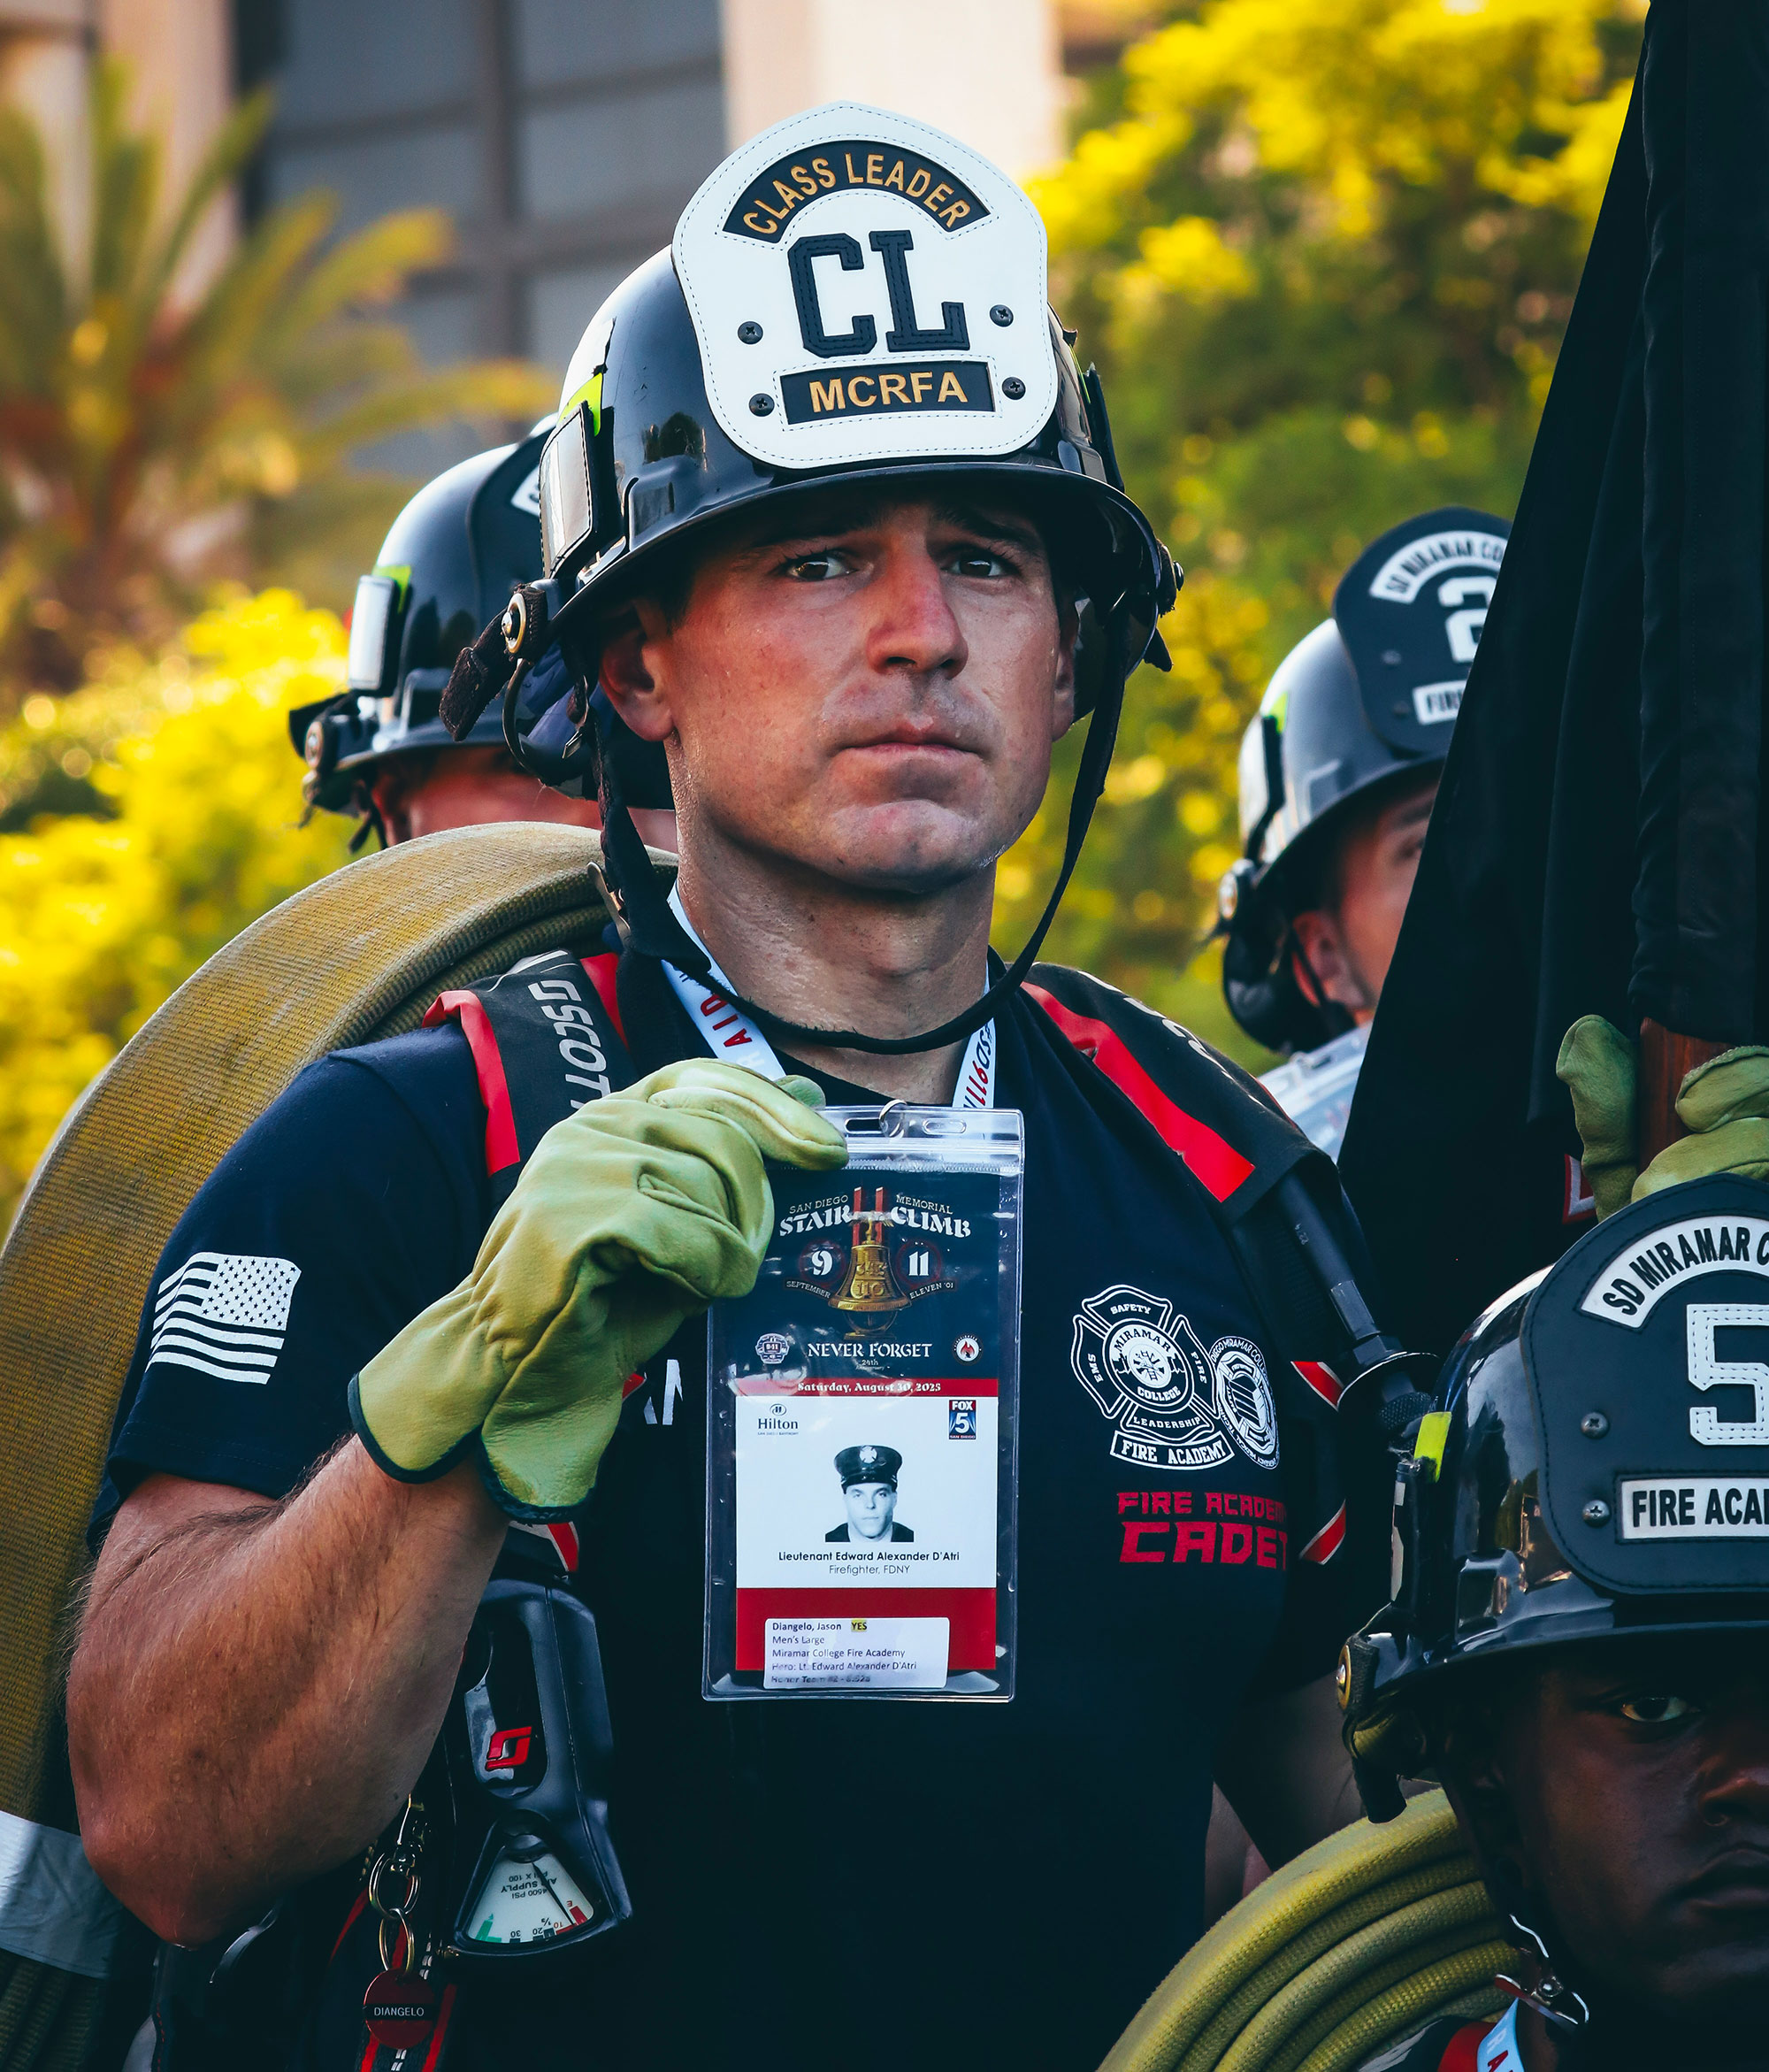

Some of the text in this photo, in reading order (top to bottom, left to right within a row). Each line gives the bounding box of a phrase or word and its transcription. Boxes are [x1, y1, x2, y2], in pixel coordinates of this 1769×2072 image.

[743, 152, 971, 234] CLASS LEADER
[787, 230, 970, 358] CL
[809, 371, 969, 413] MCRFA
[1437, 575, 1498, 664] 2
[1426, 689, 1465, 714] FIR
[541, 1005, 611, 1109] SCOT
[789, 1194, 849, 1214] SAN DIEGO
[896, 1194, 953, 1215] MEMORIAL
[779, 1204, 971, 1238] STAIR CLIMB
[811, 1250, 930, 1276] 9 11
[1603, 1278, 1645, 1316] SD
[1629, 1226, 1750, 1291] MIRAMAR
[786, 1280, 831, 1299] SEPTEMBER
[909, 1283, 941, 1300] ELEVEN
[1110, 1303, 1151, 1315] SAFETY
[808, 1343, 932, 1358] NEVER FORGET
[1114, 1329, 1172, 1352] MIRAMAR
[1087, 1351, 1207, 1384] EMS FIRE
[1686, 1303, 1769, 1446] 5
[798, 1382, 852, 1393] Saturday,
[854, 1382, 893, 1393] August
[915, 1383, 941, 1392] 2025
[1137, 1385, 1182, 1401] COLLEGE
[953, 1401, 973, 1410] FOX
[758, 1417, 798, 1430] Hilton
[955, 1412, 969, 1434] 5
[1133, 1416, 1200, 1429] LEADERSHIP
[1121, 1439, 1228, 1464] FIRE ACADEMY
[1117, 1492, 1285, 1522] FIRE ACADEM
[1632, 1488, 1769, 1529] FIRE ACA
[779, 1552, 959, 1561] Lieutenant Edward Alexander D'Atri
[829, 1565, 910, 1576] Firefighter, FDNY
[772, 1623, 815, 1632] Diangelo,
[801, 1637, 824, 1646] Large
[812, 1649, 845, 1659] College
[866, 1649, 905, 1659] Academy
[892, 1661, 917, 1670] D'Atri
[501, 1881, 538, 1893] SUPPLY
[374, 2007, 425, 2016] DIANGELO
